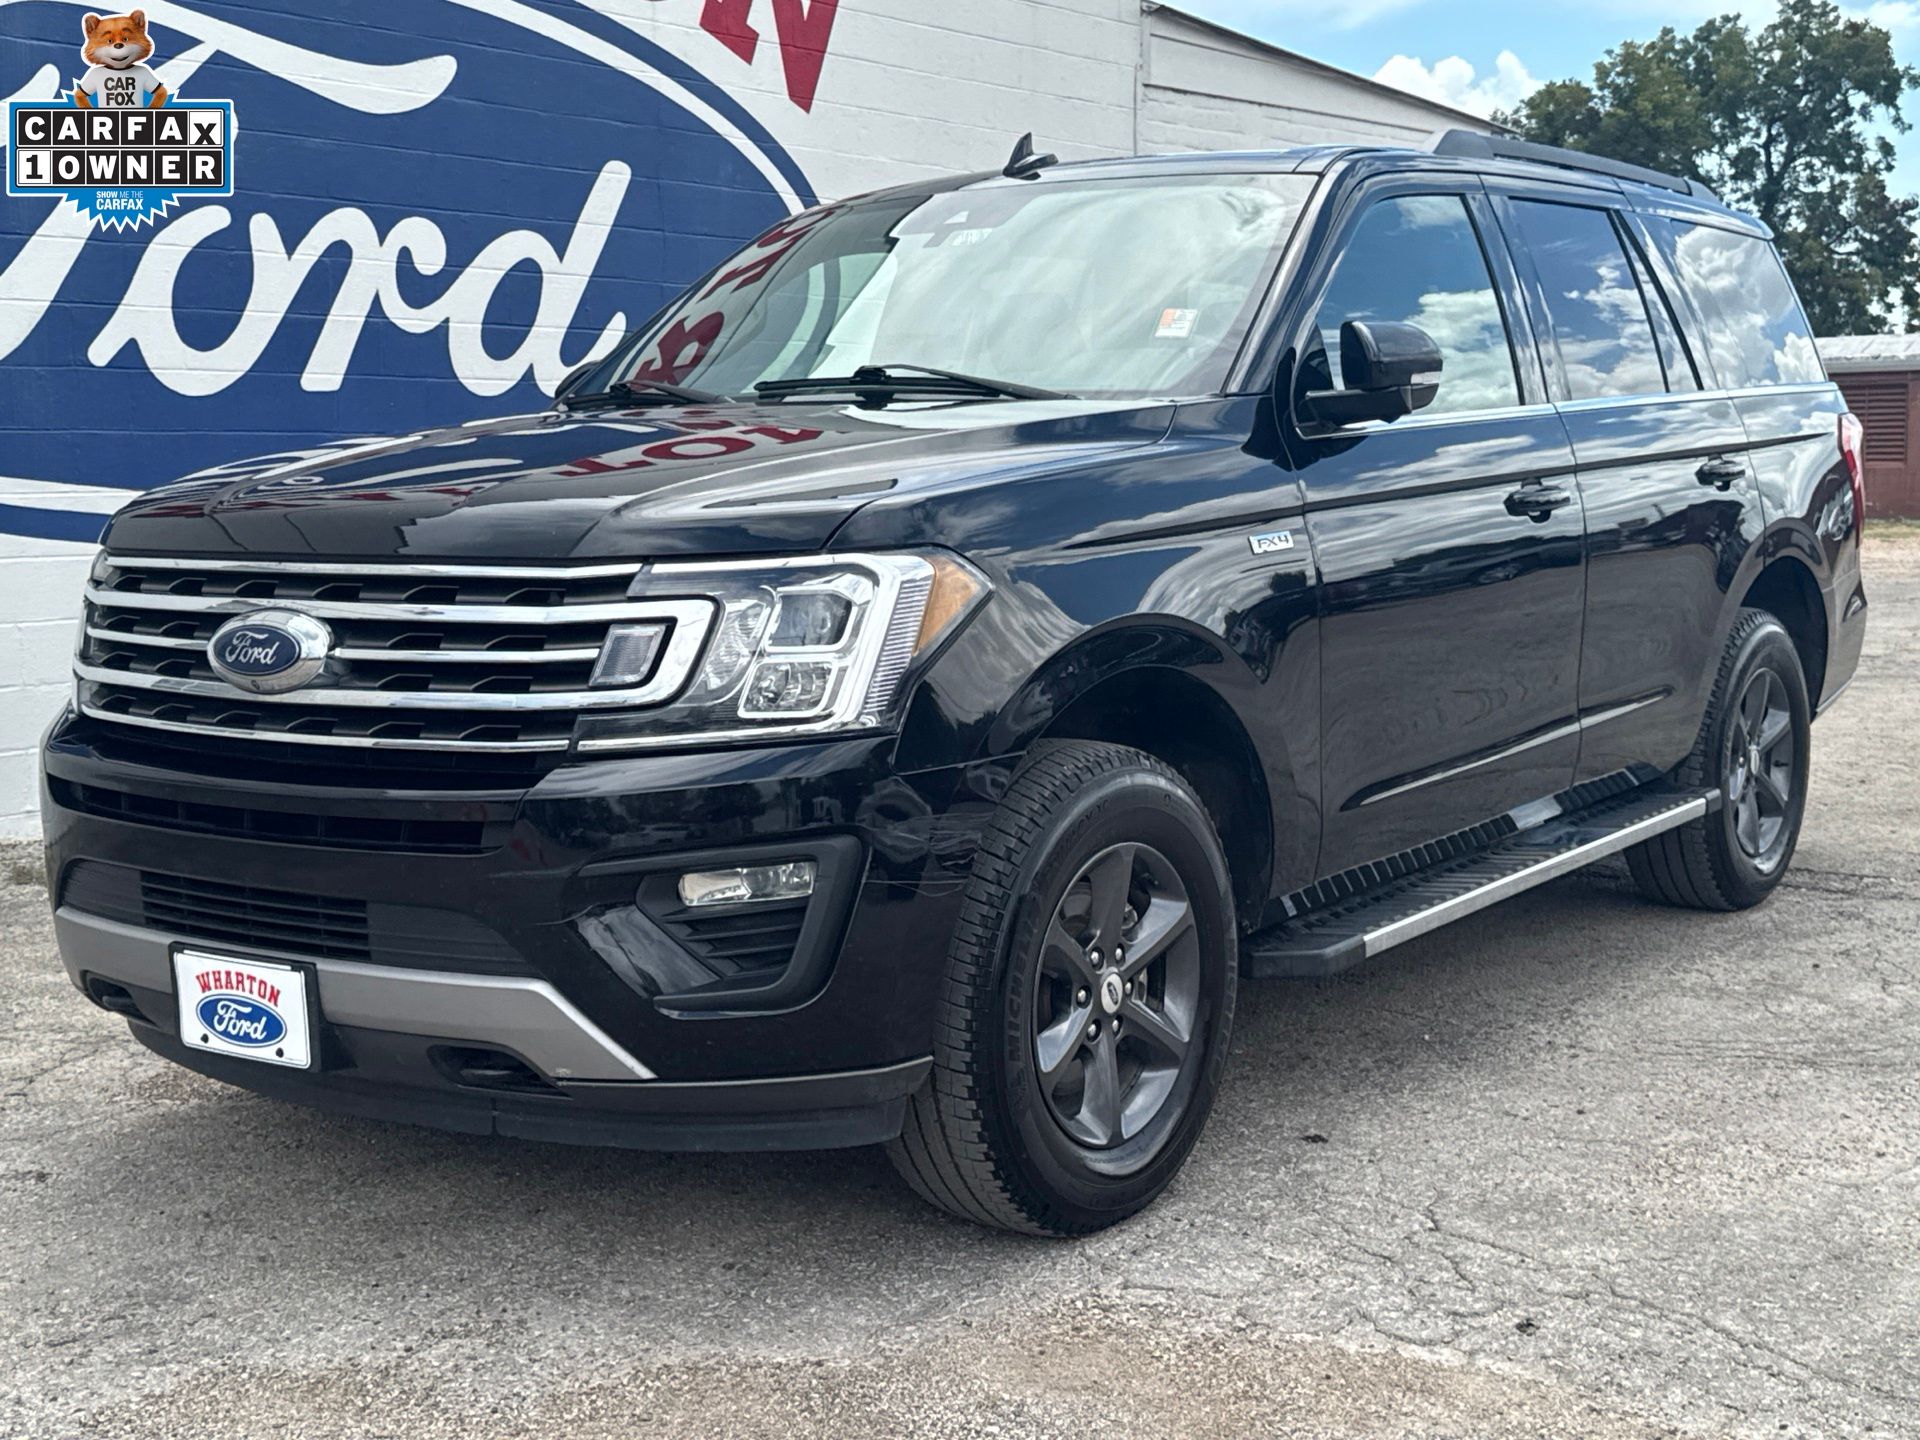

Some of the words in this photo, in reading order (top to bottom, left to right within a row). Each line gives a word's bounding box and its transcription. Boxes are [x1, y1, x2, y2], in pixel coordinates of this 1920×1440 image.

[1256, 534, 1290, 550] FX4
[225, 631, 280, 664] Ford
[195, 970, 281, 1007] WHARTON
[213, 1000, 267, 1040] Ford
